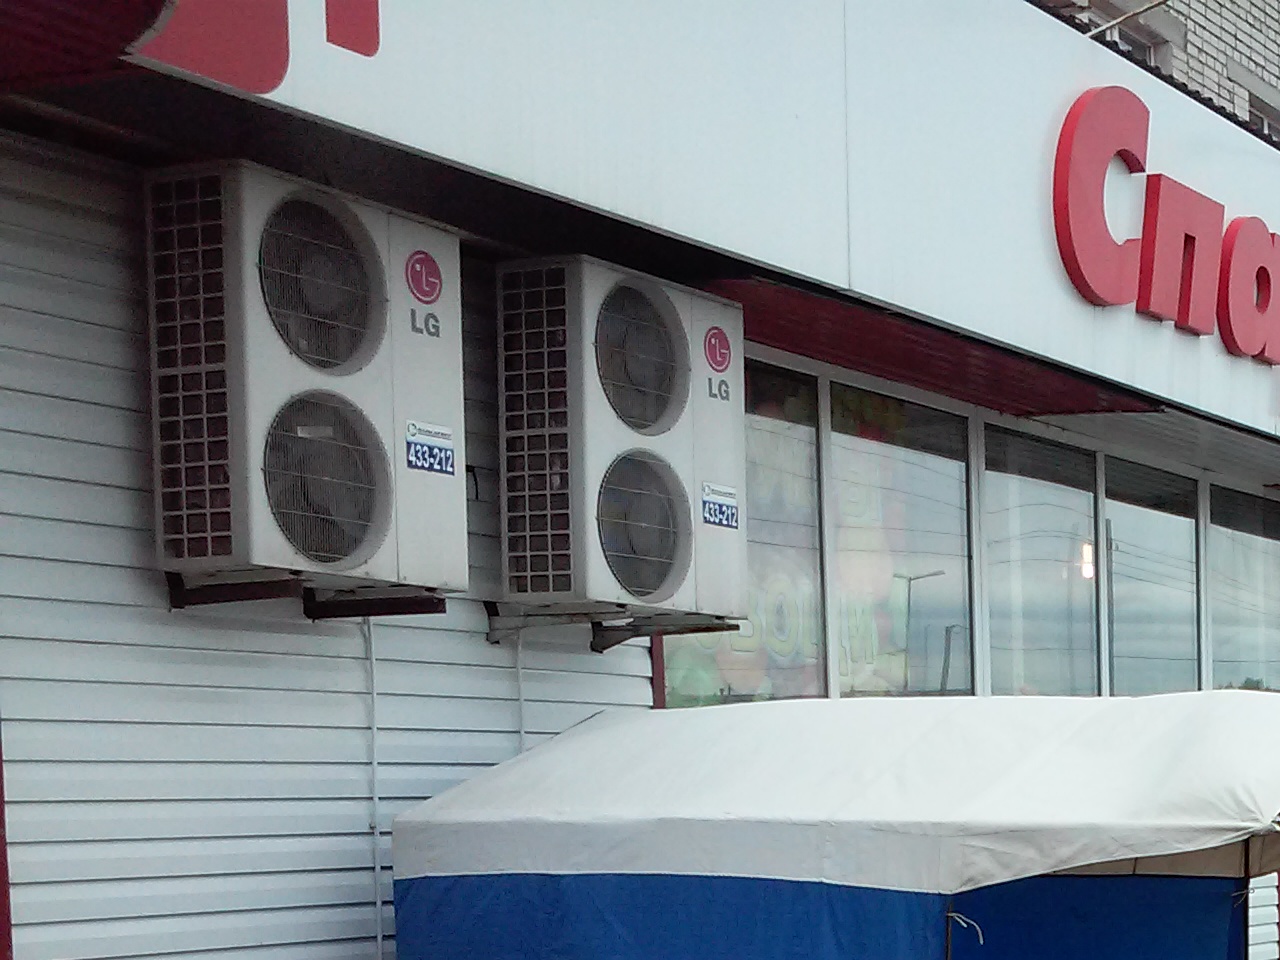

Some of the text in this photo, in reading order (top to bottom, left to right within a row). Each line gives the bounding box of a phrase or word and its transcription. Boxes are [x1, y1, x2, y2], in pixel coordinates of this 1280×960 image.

[410, 308, 441, 338] LG
[707, 377, 730, 402] LG
[408, 443, 454, 472] 433-212
[704, 502, 738, 527] 433-212
